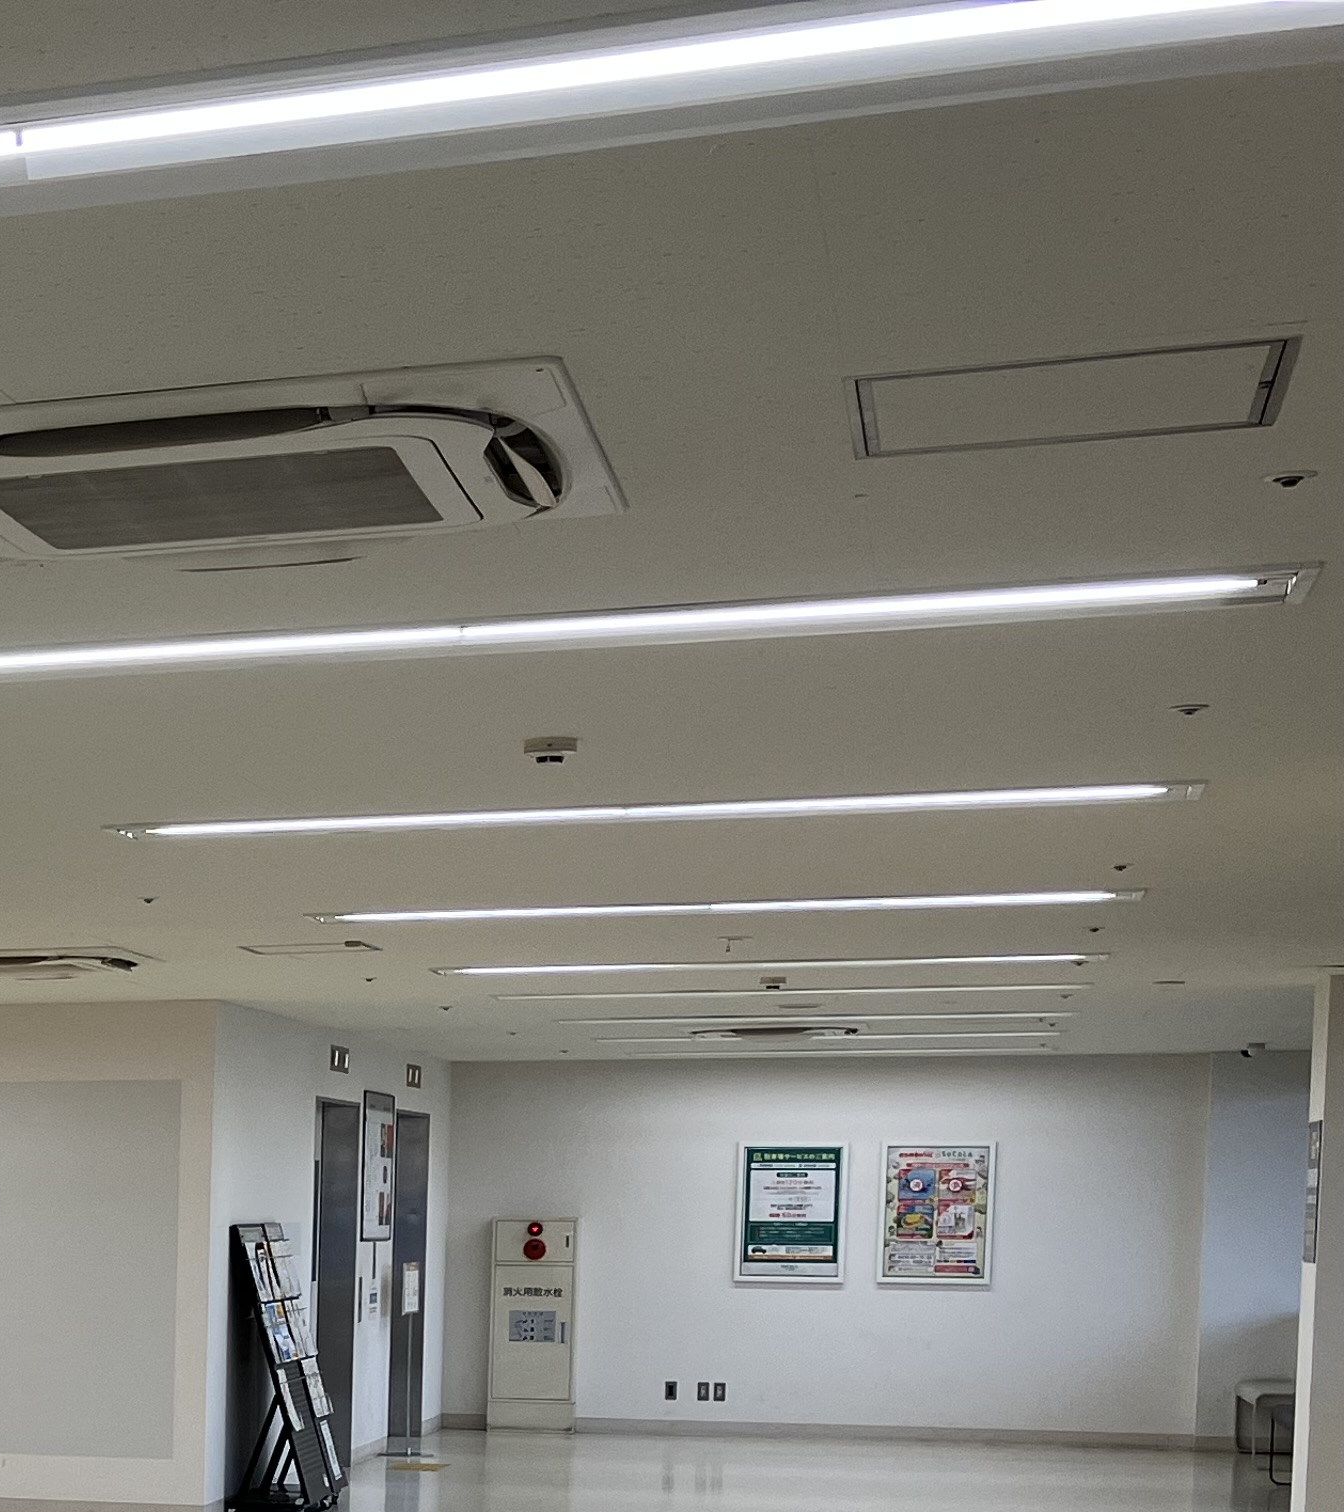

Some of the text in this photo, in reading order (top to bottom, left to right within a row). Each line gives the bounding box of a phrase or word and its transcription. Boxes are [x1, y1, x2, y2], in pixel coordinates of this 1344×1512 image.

[503, 1287, 563, 1298] 消火用散水栓
